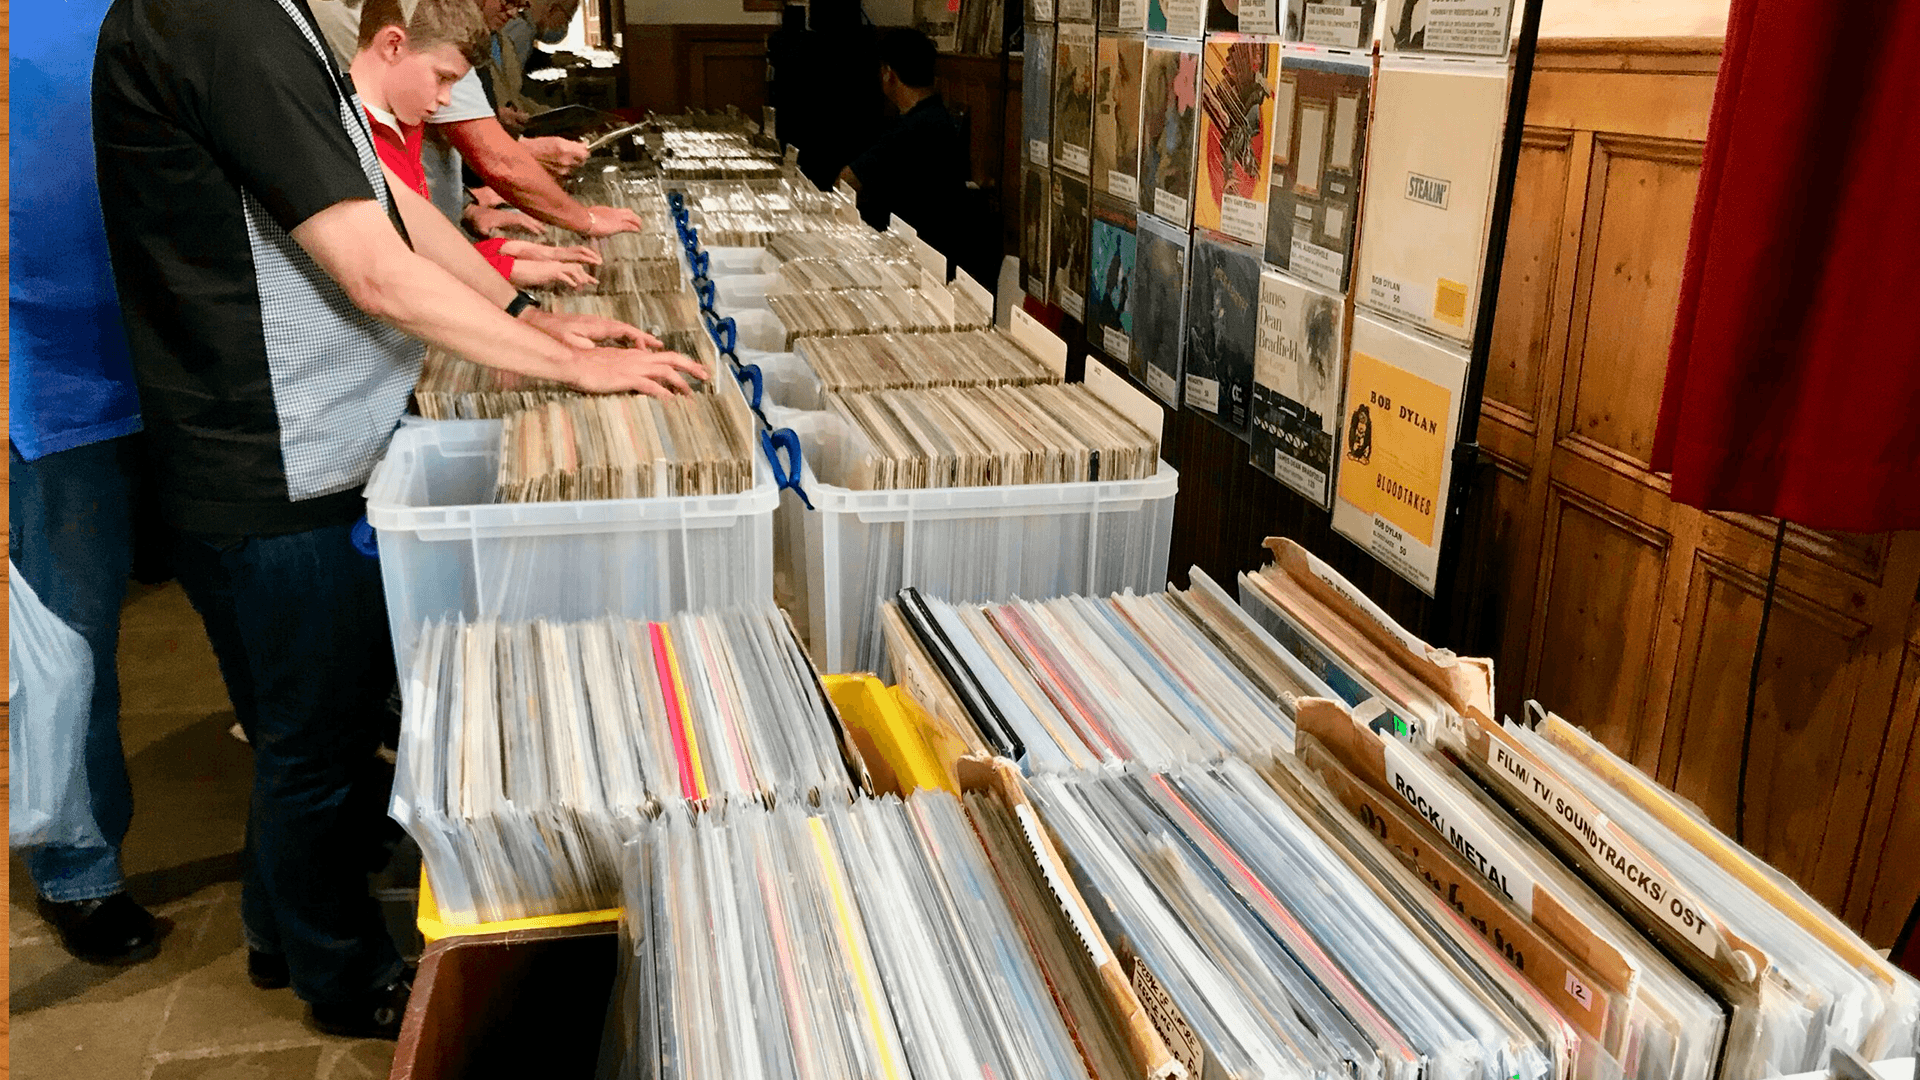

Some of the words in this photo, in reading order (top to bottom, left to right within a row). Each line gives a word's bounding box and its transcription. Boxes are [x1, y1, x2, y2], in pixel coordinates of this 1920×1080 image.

[1492, 7, 1501, 17] 75
[1409, 176, 1447, 205] STEALIN'
[1261, 281, 1286, 310] James
[1372, 275, 1383, 286] BOB
[1383, 277, 1400, 292] DYLAN
[1393, 294, 1400, 304] 50
[1260, 304, 1282, 333] Dean
[1259, 328, 1298, 362] Bradfield
[1370, 390, 1391, 411] BOB
[1399, 405, 1437, 435] DYLAN
[1376, 473, 1431, 516] BLOODTAKES
[1375, 518, 1384, 530] BOB
[1385, 525, 1402, 541] DYLAN
[1399, 546, 1407, 556] 50
[1395, 772, 1445, 834] ROCK/
[1450, 826, 1513, 900] METAL
[1497, 749, 1529, 785] FILM/
[1532, 776, 1554, 805] TV/
[1555, 796, 1668, 906] SOUNDTRACKS/
[1670, 898, 1707, 935] OST
[1570, 980, 1587, 999] 12
